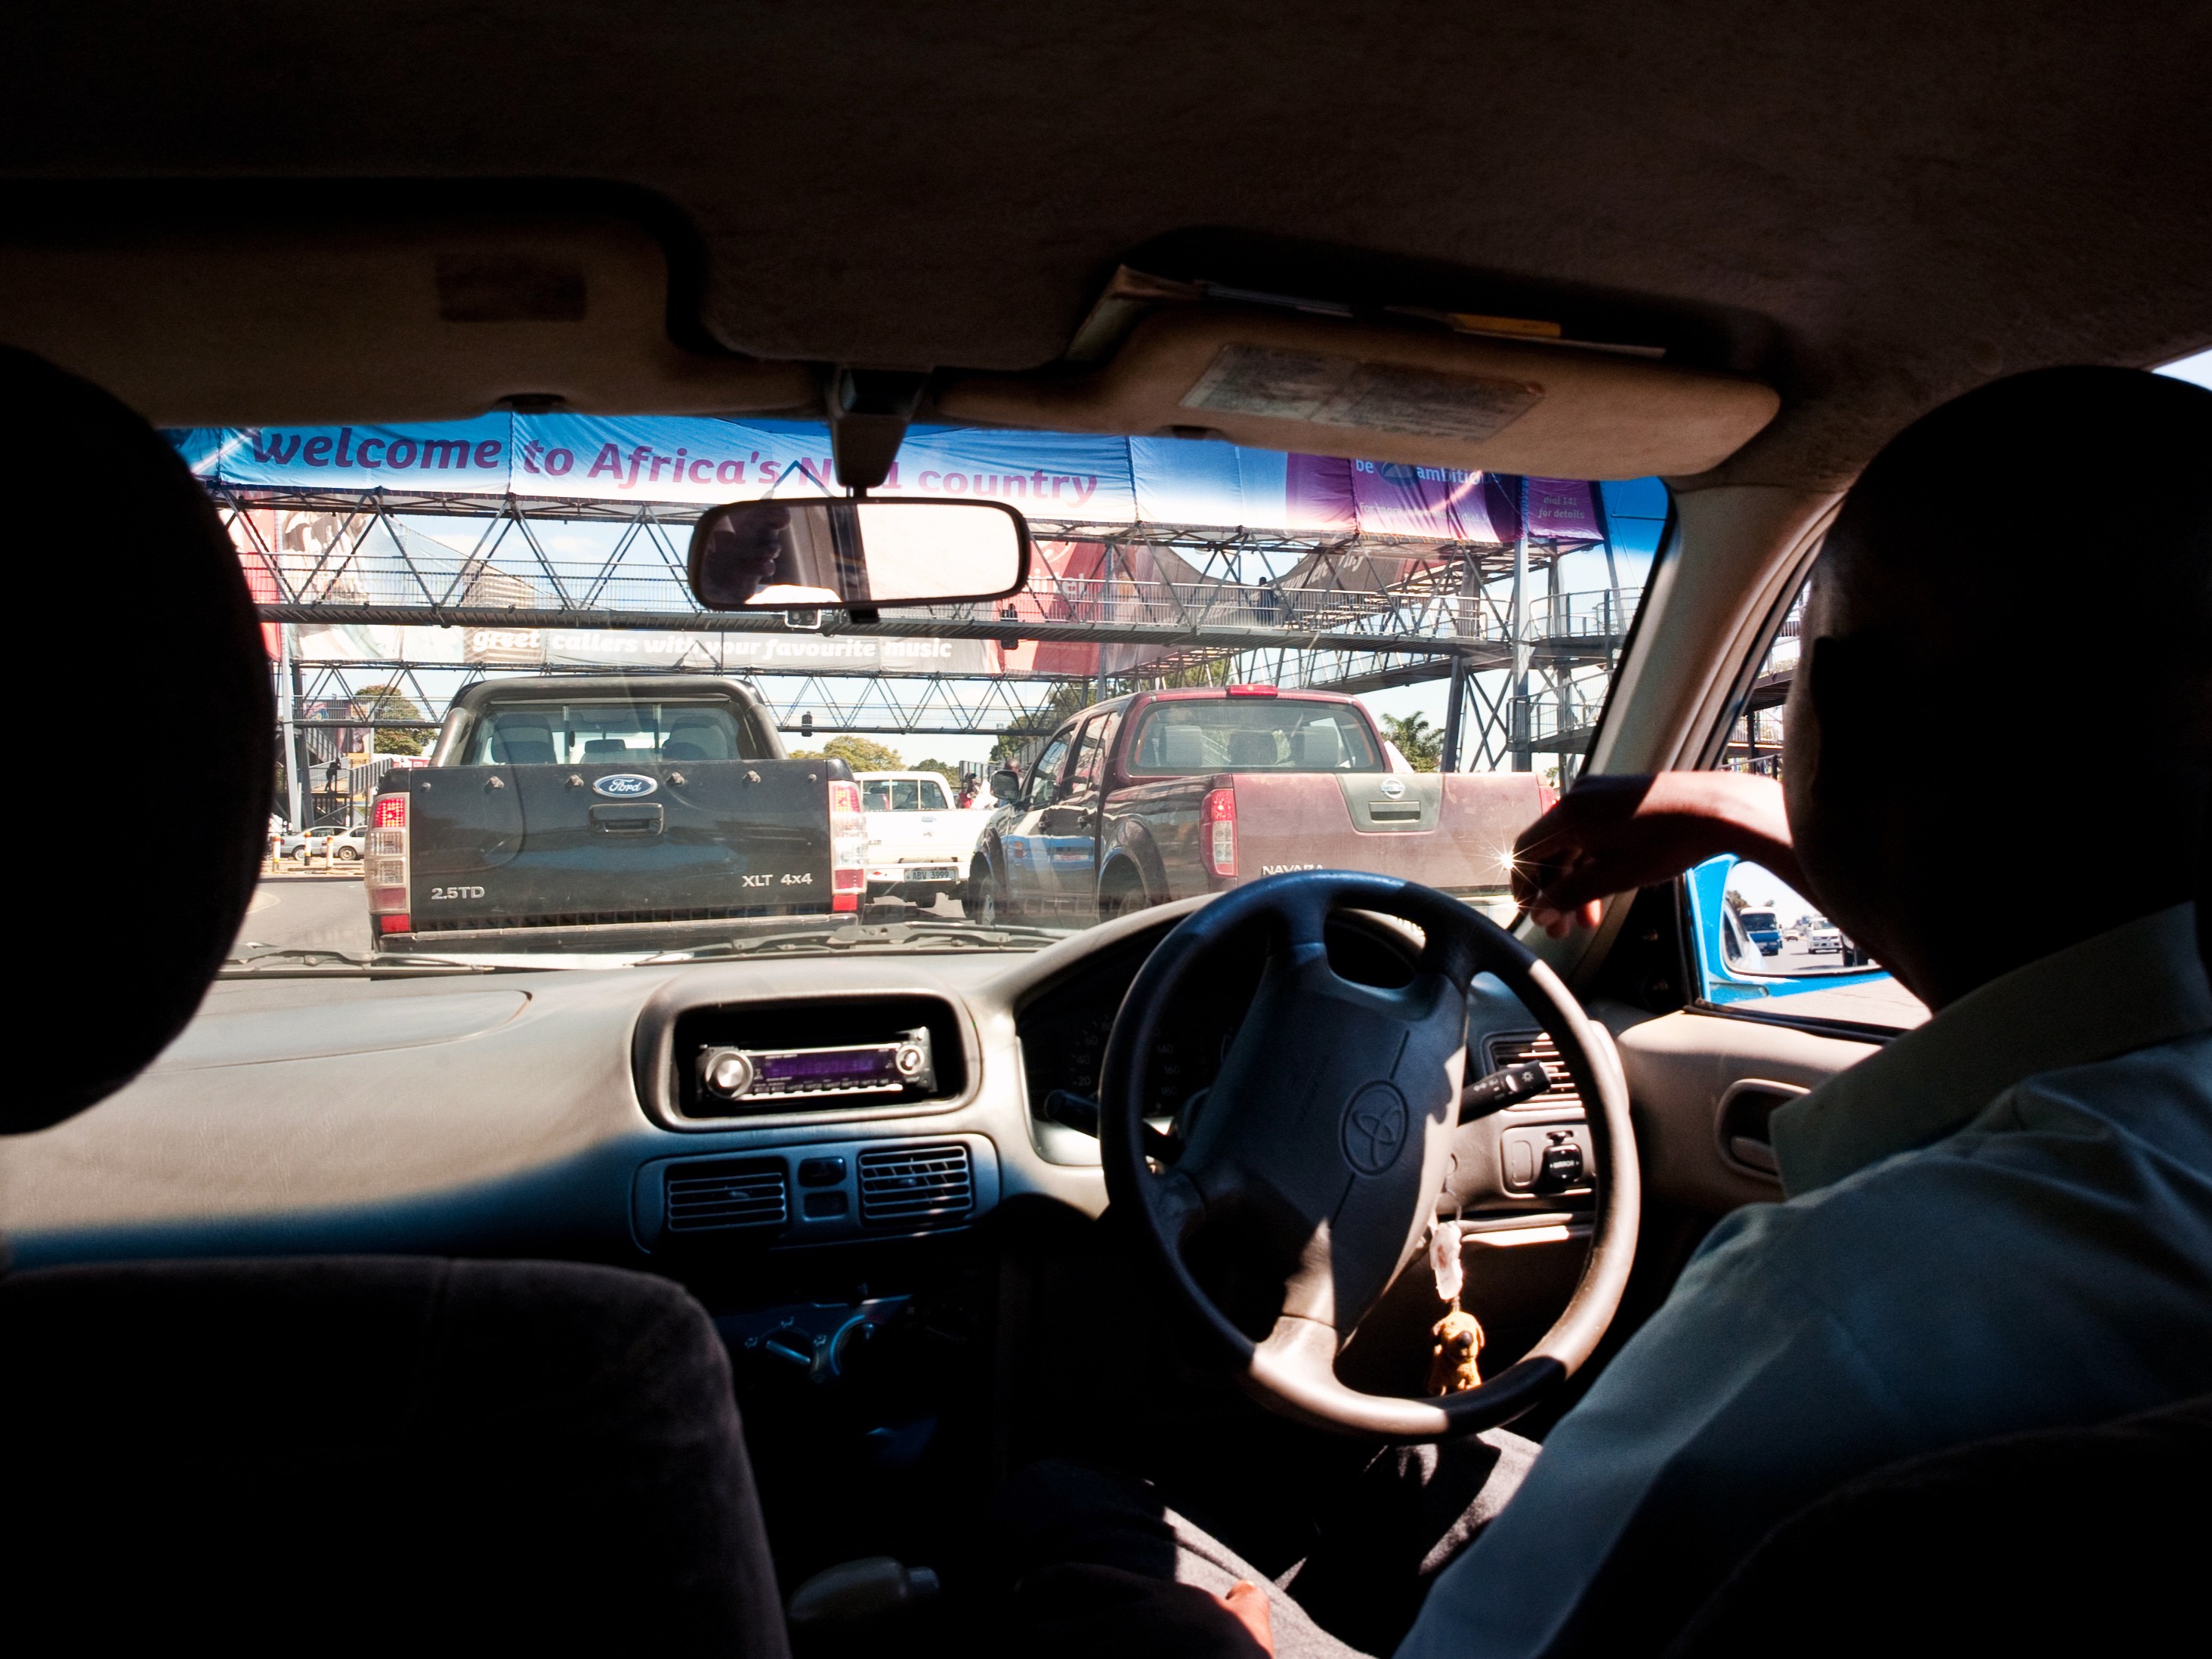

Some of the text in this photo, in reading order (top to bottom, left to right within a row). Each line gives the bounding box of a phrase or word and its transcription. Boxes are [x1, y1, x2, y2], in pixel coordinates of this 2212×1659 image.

[251, 428, 502, 469] welcome
[524, 439, 574, 476] to
[587, 443, 782, 490] Africa's
[918, 468, 1098, 508] country
[1356, 459, 1374, 474] be
[1543, 496, 1577, 506] dial 141
[1538, 508, 1585, 519] for details
[471, 628, 953, 660] greet callers with your favourite music
[608, 779, 642, 792] Ford
[741, 873, 813, 888] XLT 4x4
[431, 885, 485, 900] 2.5TD
